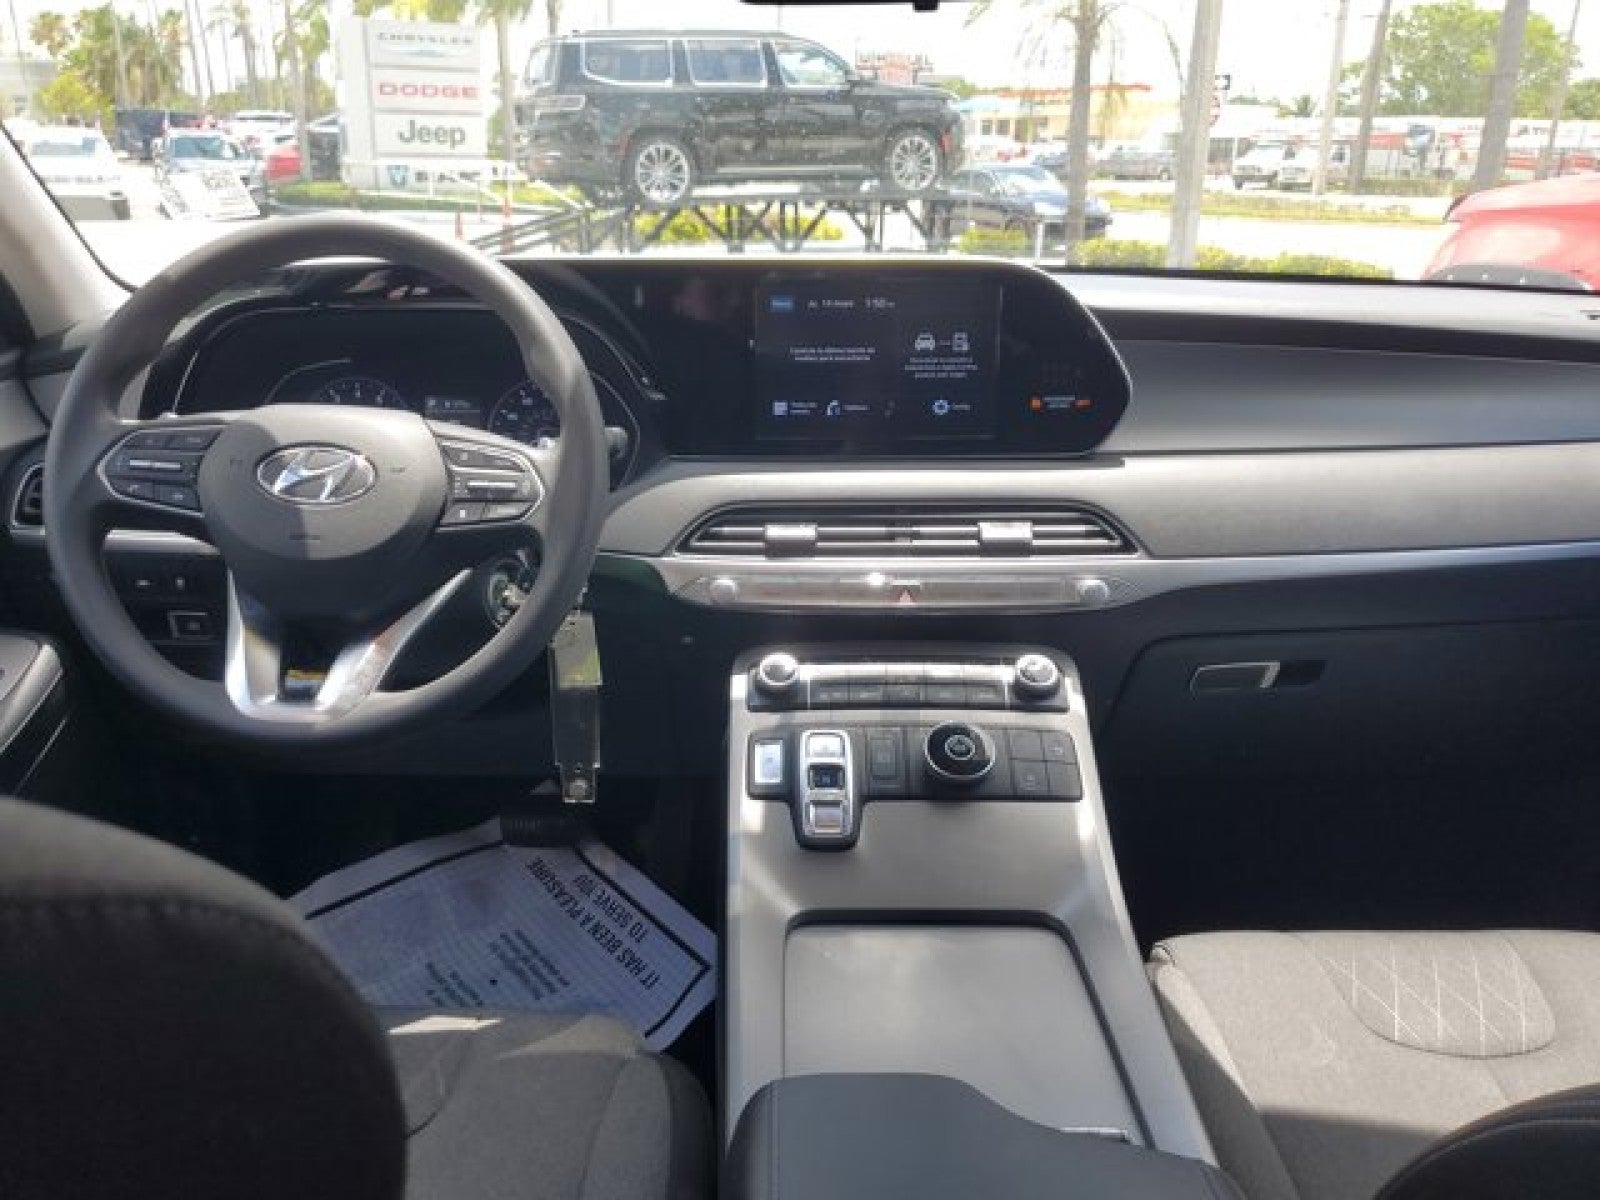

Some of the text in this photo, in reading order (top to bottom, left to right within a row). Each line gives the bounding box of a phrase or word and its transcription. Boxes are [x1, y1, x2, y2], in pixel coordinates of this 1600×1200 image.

[379, 84, 479, 98] DODGE
[398, 119, 466, 150] Jeep
[593, 890, 634, 929] SERVE
[586, 919, 624, 955] BEEN
[627, 922, 649, 943] TO
[616, 946, 649, 978] HAS
[639, 969, 661, 990] IT
